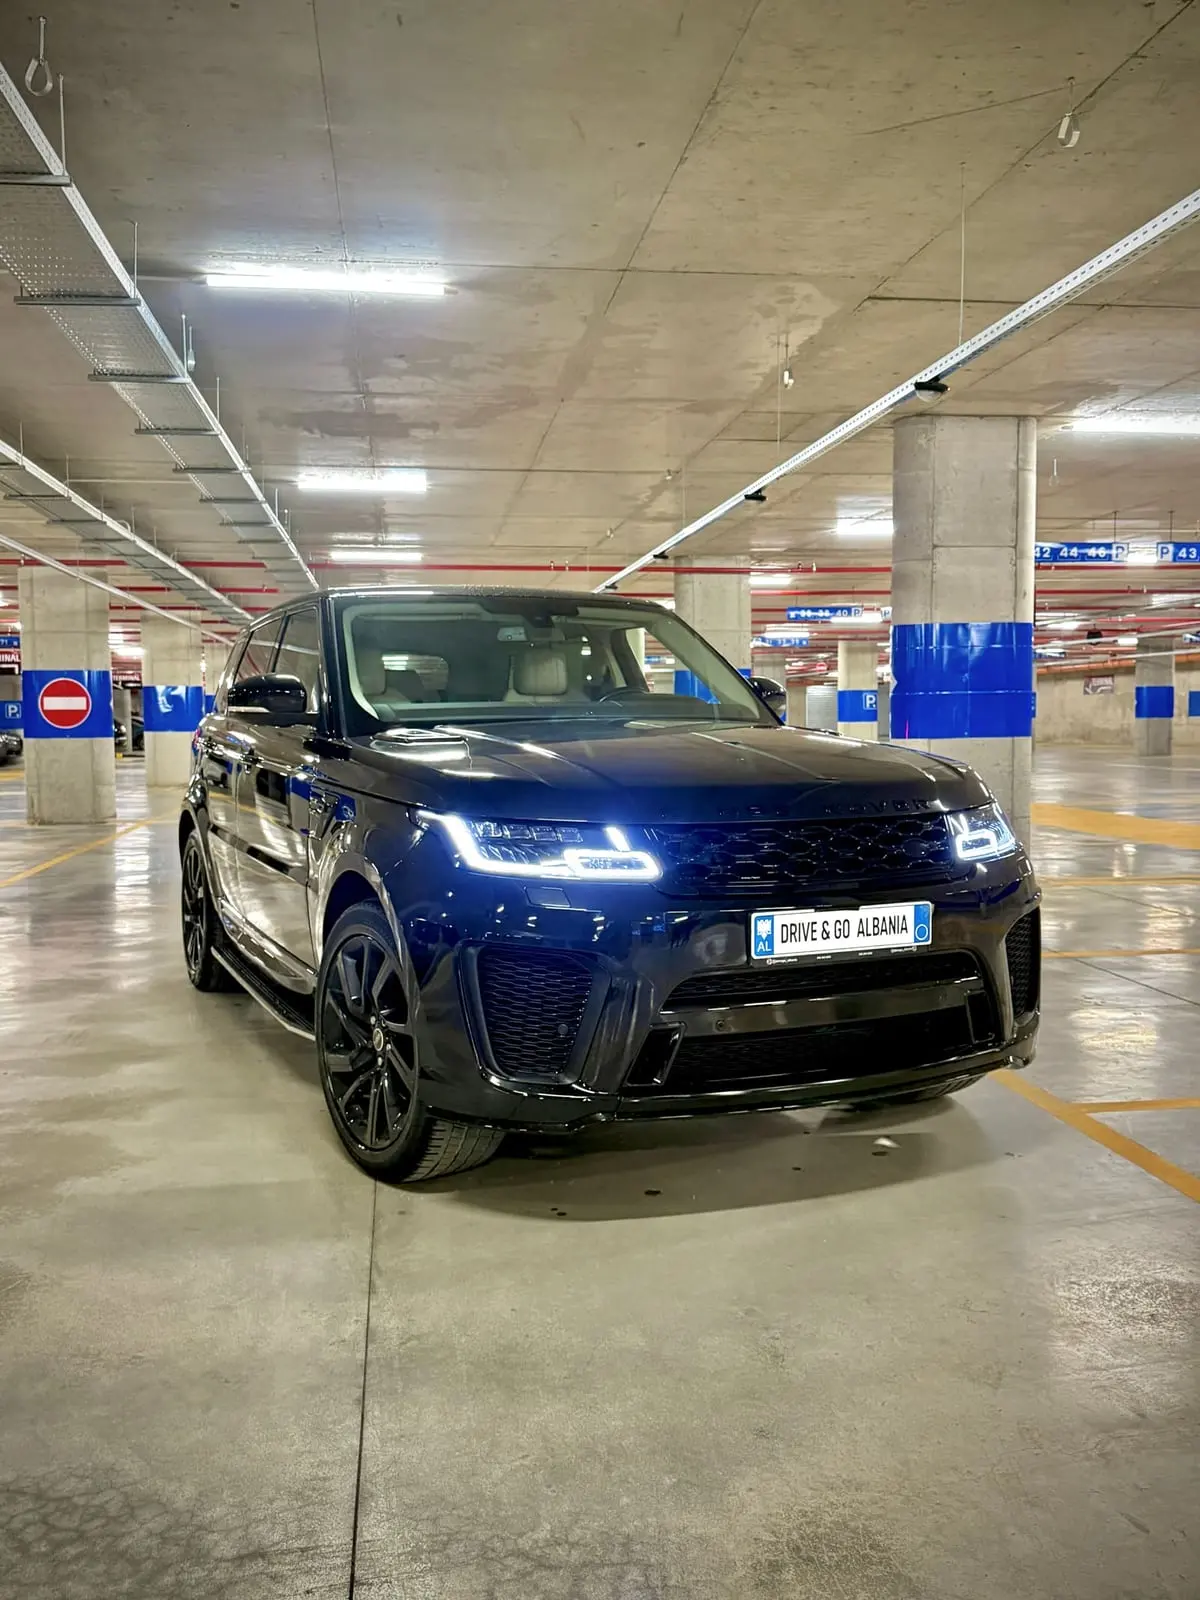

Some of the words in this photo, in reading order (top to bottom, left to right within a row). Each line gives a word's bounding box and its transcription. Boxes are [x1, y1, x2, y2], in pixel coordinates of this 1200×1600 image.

[1060, 546, 1078, 558] 44
[1115, 546, 1125, 559] P
[1160, 546, 1170, 560] P
[1178, 547, 1198, 559] 43
[780, 921, 818, 944] DRIVE
[821, 920, 831, 940] &
[834, 919, 851, 939] GO
[857, 914, 909, 938] ALBANIA
[757, 942, 772, 952] AL
